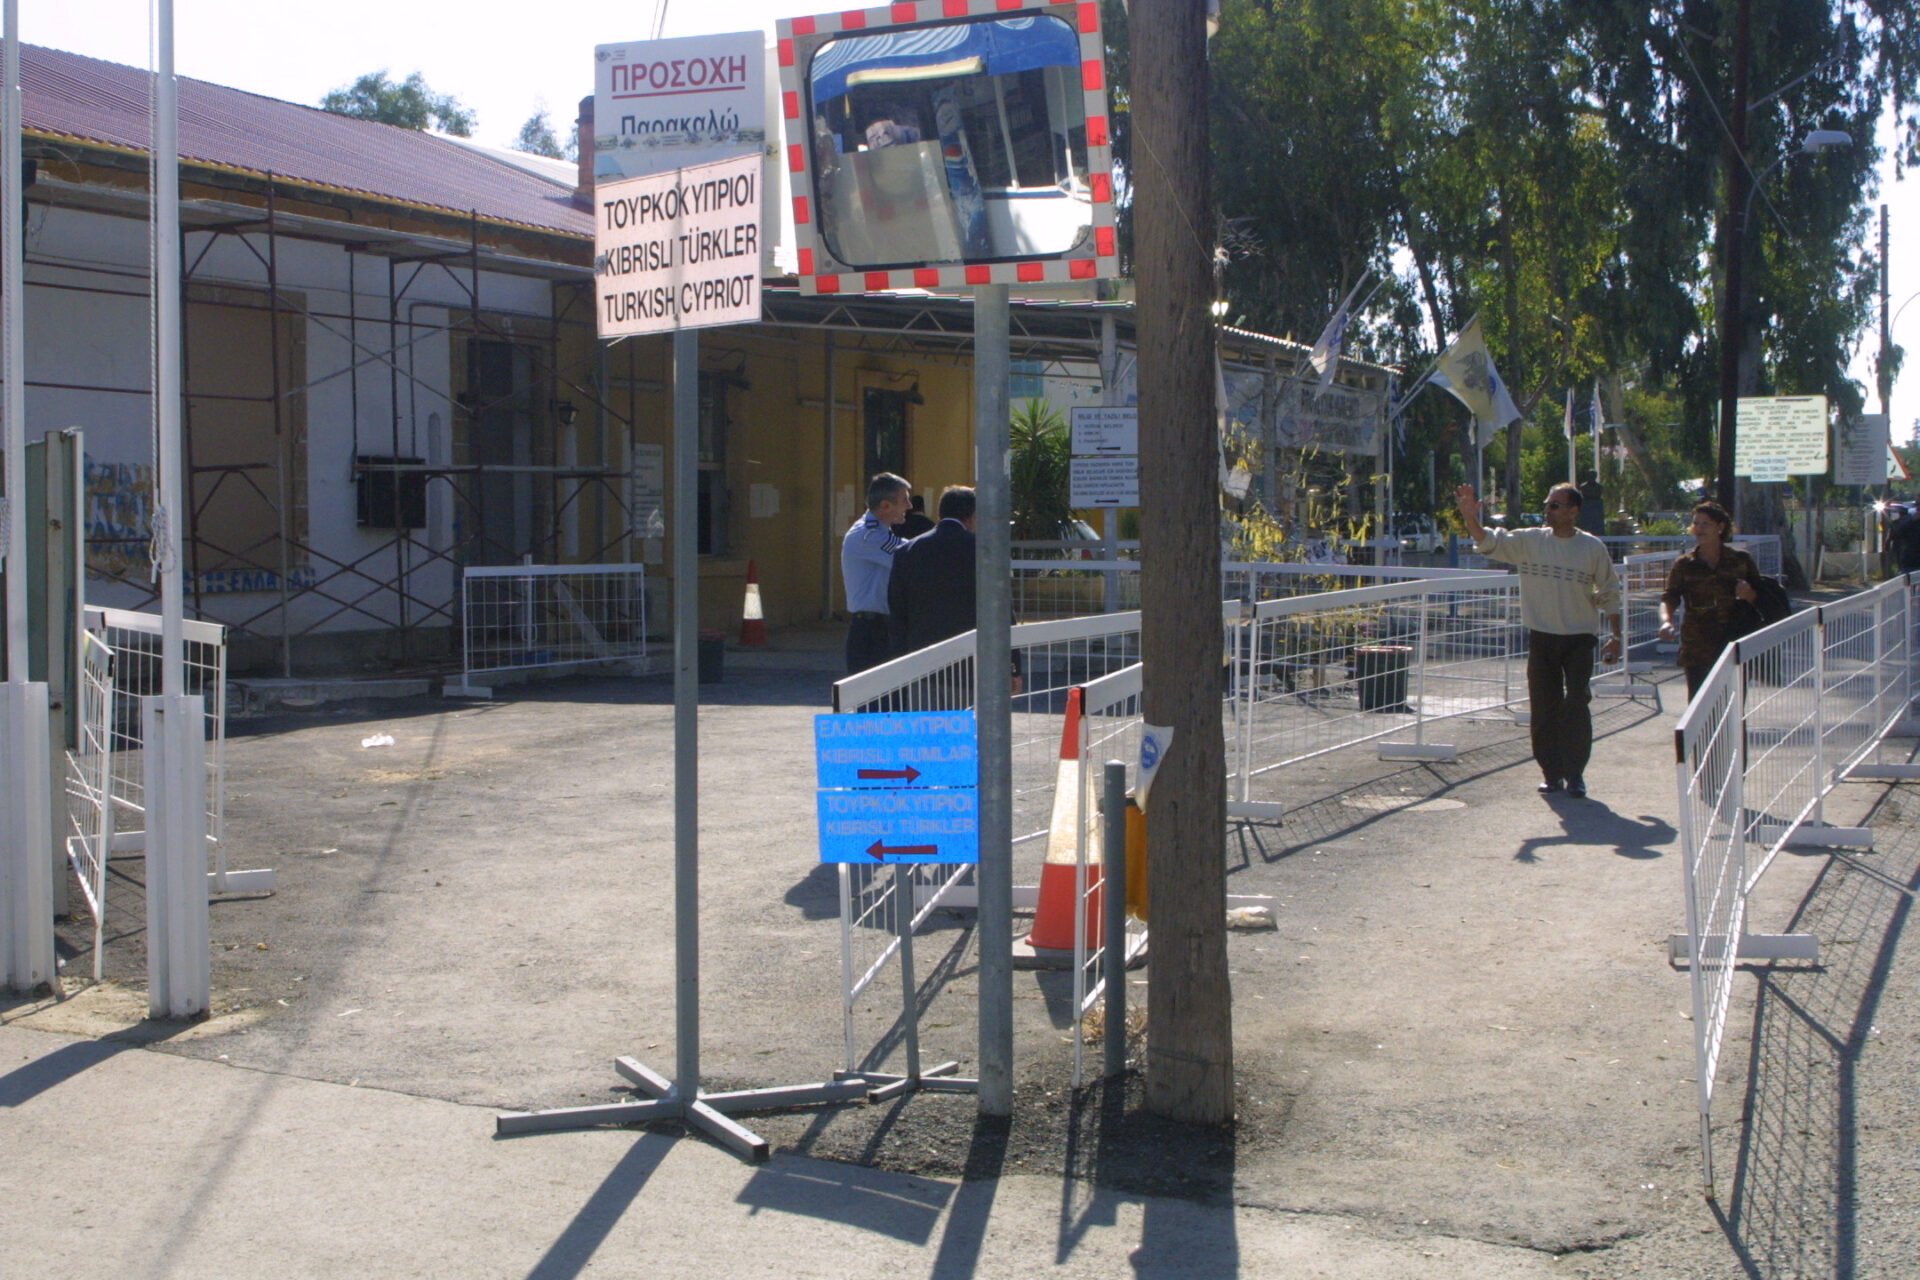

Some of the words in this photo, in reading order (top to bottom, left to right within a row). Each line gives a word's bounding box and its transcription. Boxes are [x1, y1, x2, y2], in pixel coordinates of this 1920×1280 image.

[611, 54, 746, 93] ΠΡΟΣΟΧΗ
[621, 107, 739, 135] Παρακαλώ
[603, 172, 755, 231] ΤΟΥΡΚΟΚΥΠΡΙΟΙ
[604, 238, 673, 277] KIBRISLI
[679, 223, 758, 266] TÜRKLER
[603, 286, 676, 324] TURKISH
[680, 274, 755, 315] CYPRIOT
